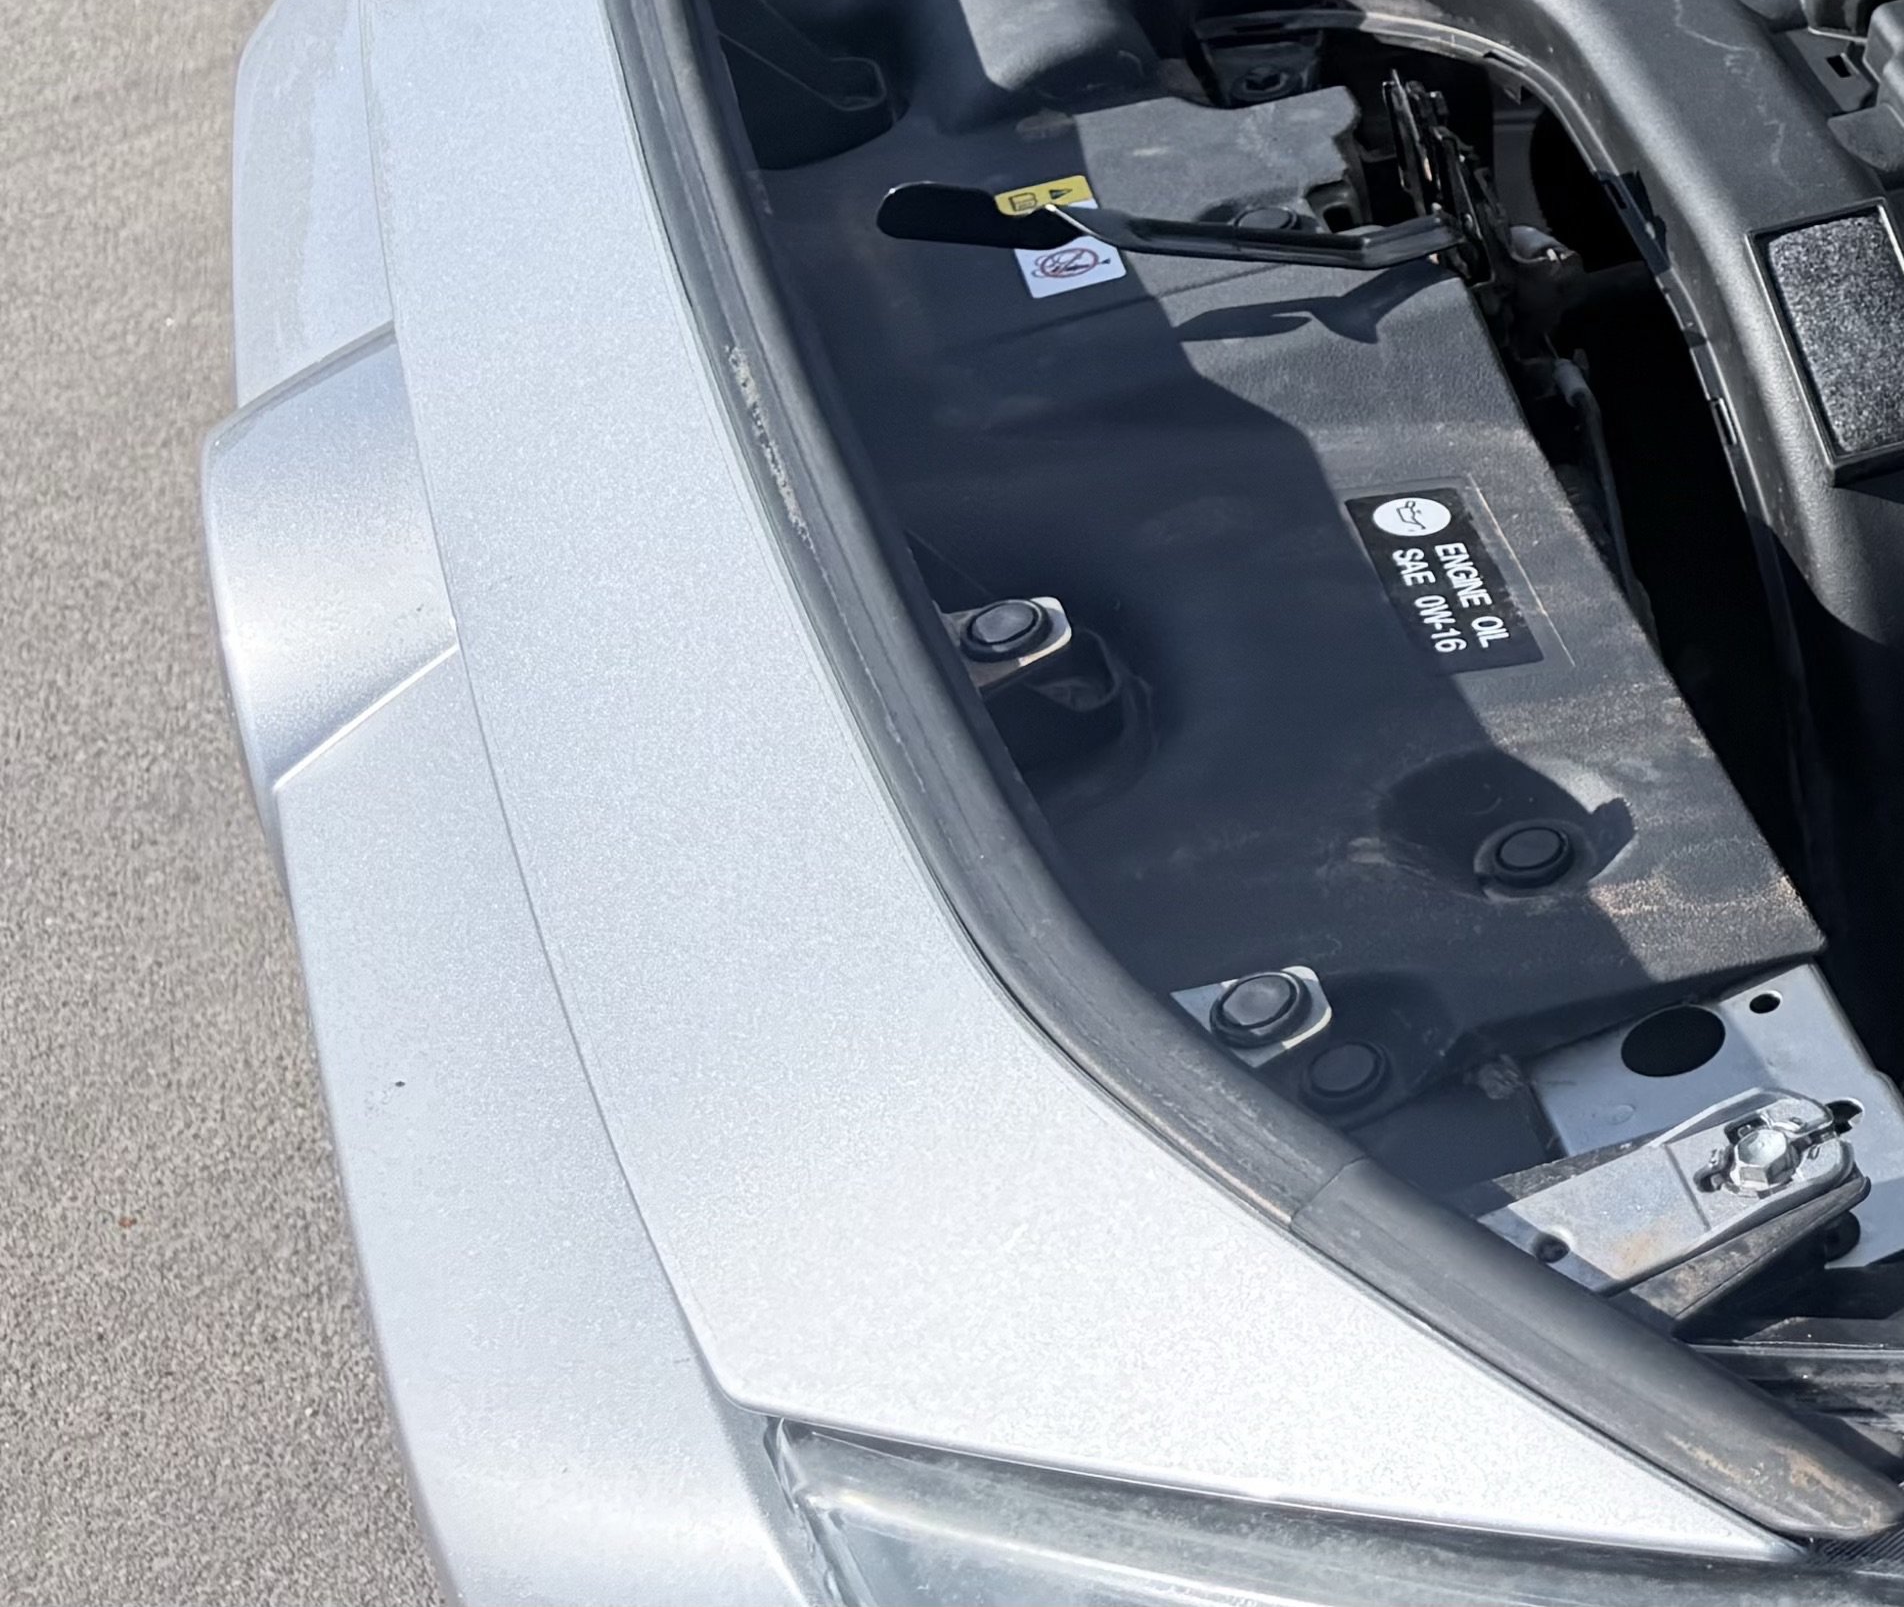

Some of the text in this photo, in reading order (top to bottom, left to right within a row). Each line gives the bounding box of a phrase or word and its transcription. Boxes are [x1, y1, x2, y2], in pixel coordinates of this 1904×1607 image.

[1392, 547, 1467, 653] SAE 0W-16
[1434, 542, 1510, 649] ENGINE OIL
